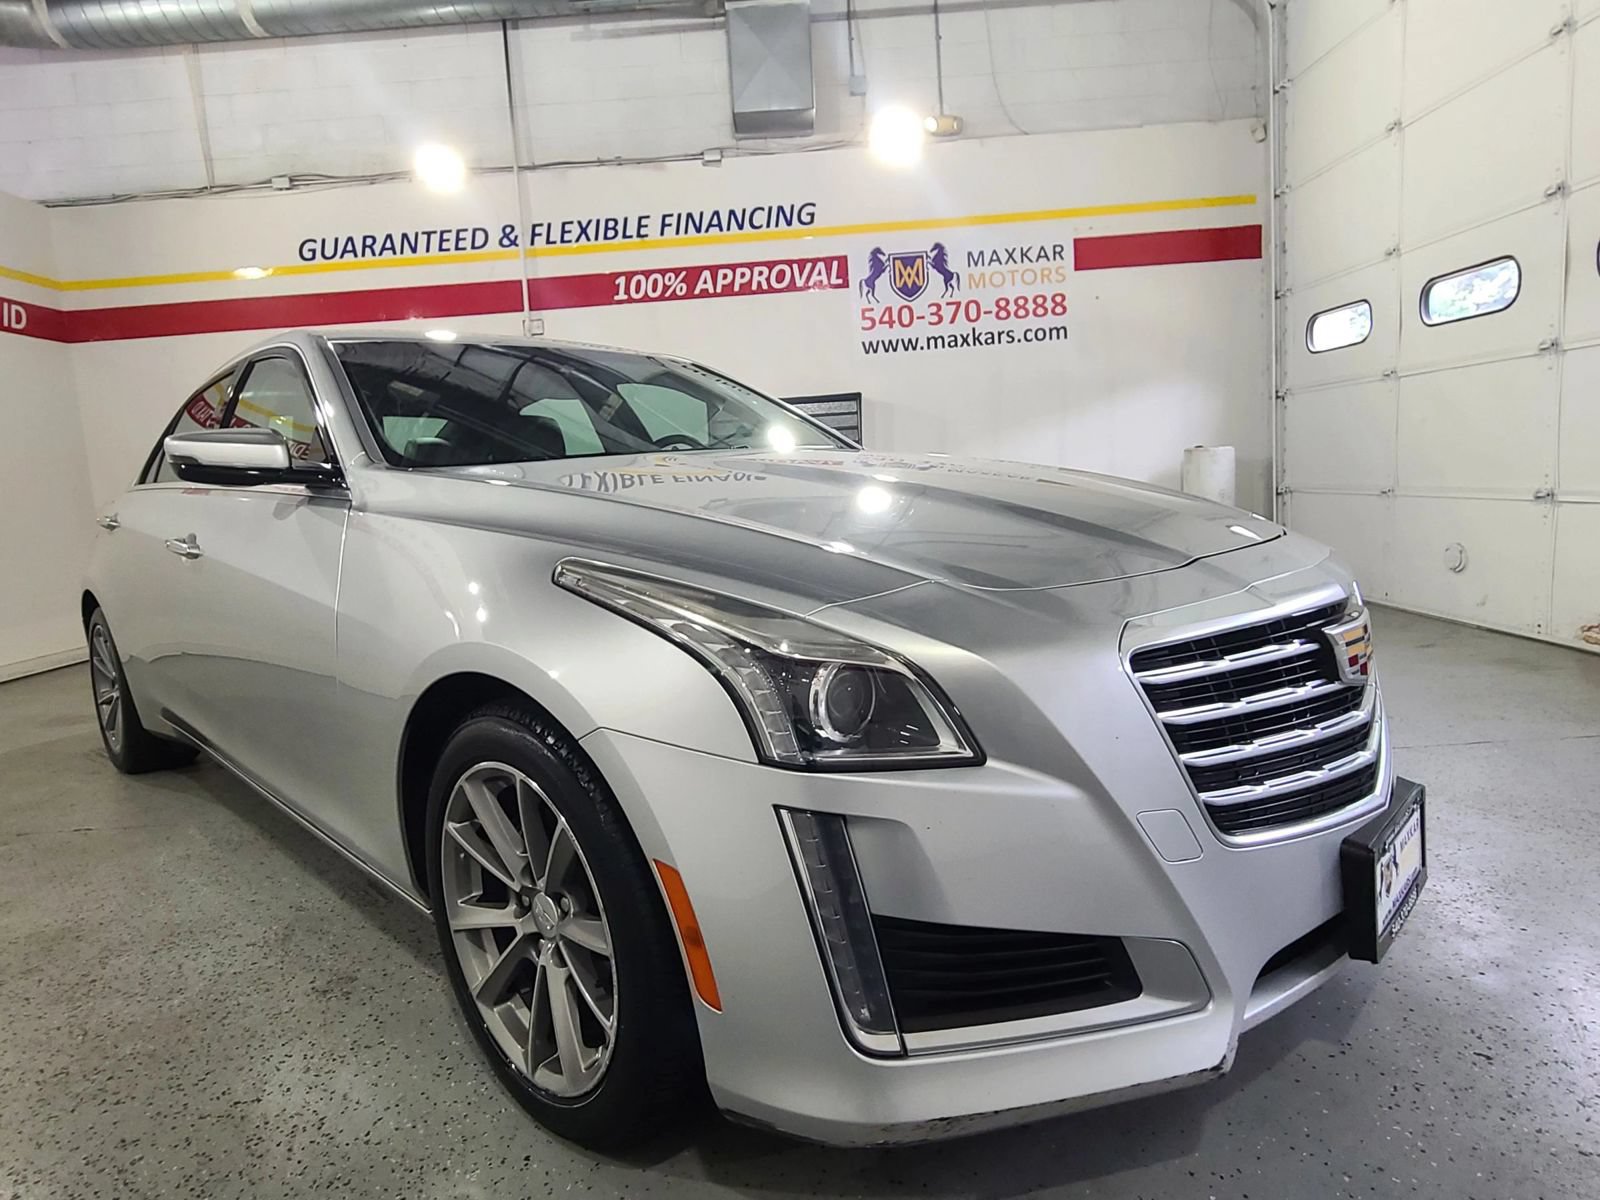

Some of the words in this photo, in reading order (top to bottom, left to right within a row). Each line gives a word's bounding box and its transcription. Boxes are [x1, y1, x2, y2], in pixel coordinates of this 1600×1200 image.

[298, 227, 490, 262] GUARANTEED
[498, 224, 519, 249] &
[529, 214, 651, 247] FLEXIBLE
[659, 202, 817, 237] FINANCING
[966, 244, 1066, 268] MAXKAR
[613, 271, 688, 301] 100%
[693, 260, 844, 295] APPROVAL
[967, 266, 1067, 290] MOTORS
[3, 301, 27, 329] ID
[860, 292, 1069, 332] 540-370-8888
[861, 325, 1069, 355] www.maxkars.com
